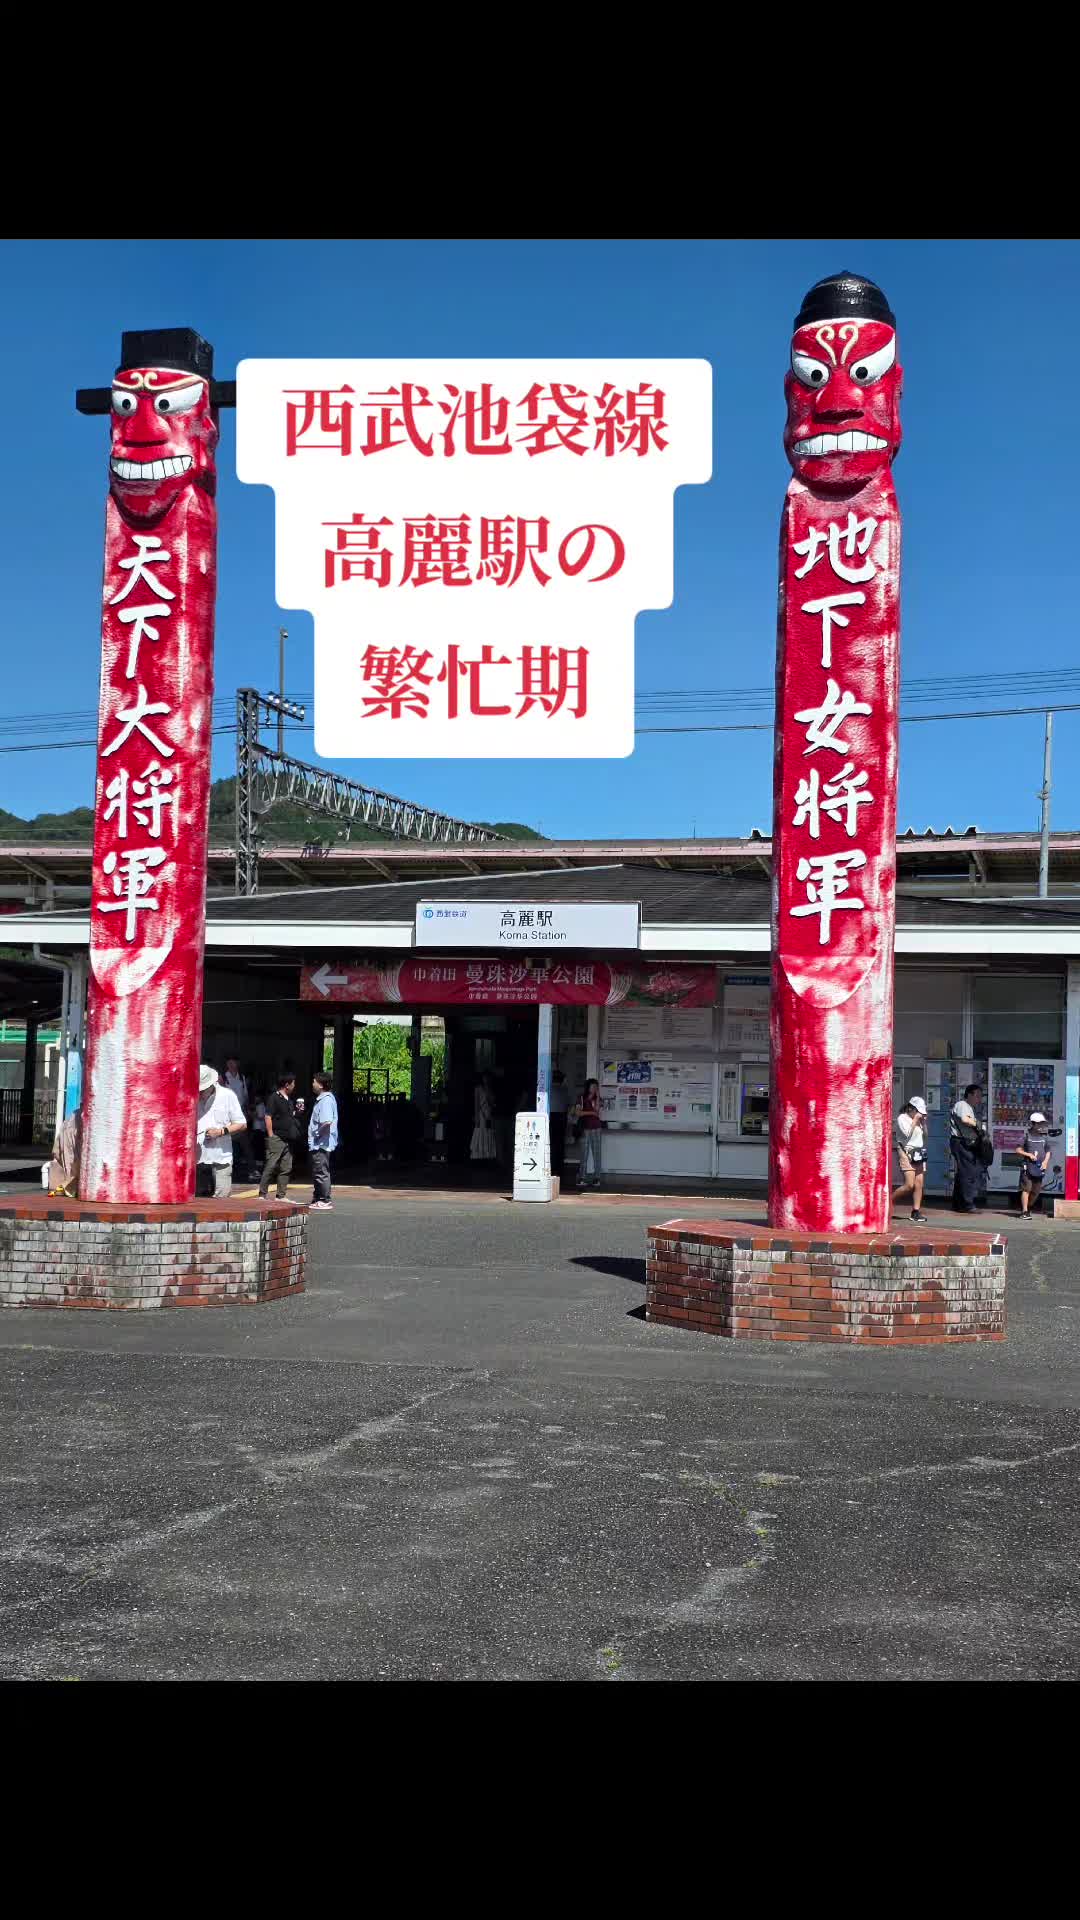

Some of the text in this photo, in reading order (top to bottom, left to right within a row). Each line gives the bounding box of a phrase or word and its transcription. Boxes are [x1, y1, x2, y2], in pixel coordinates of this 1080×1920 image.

[500, 910, 553, 927] 高麗駅
[499, 931, 567, 940] Koma Station
